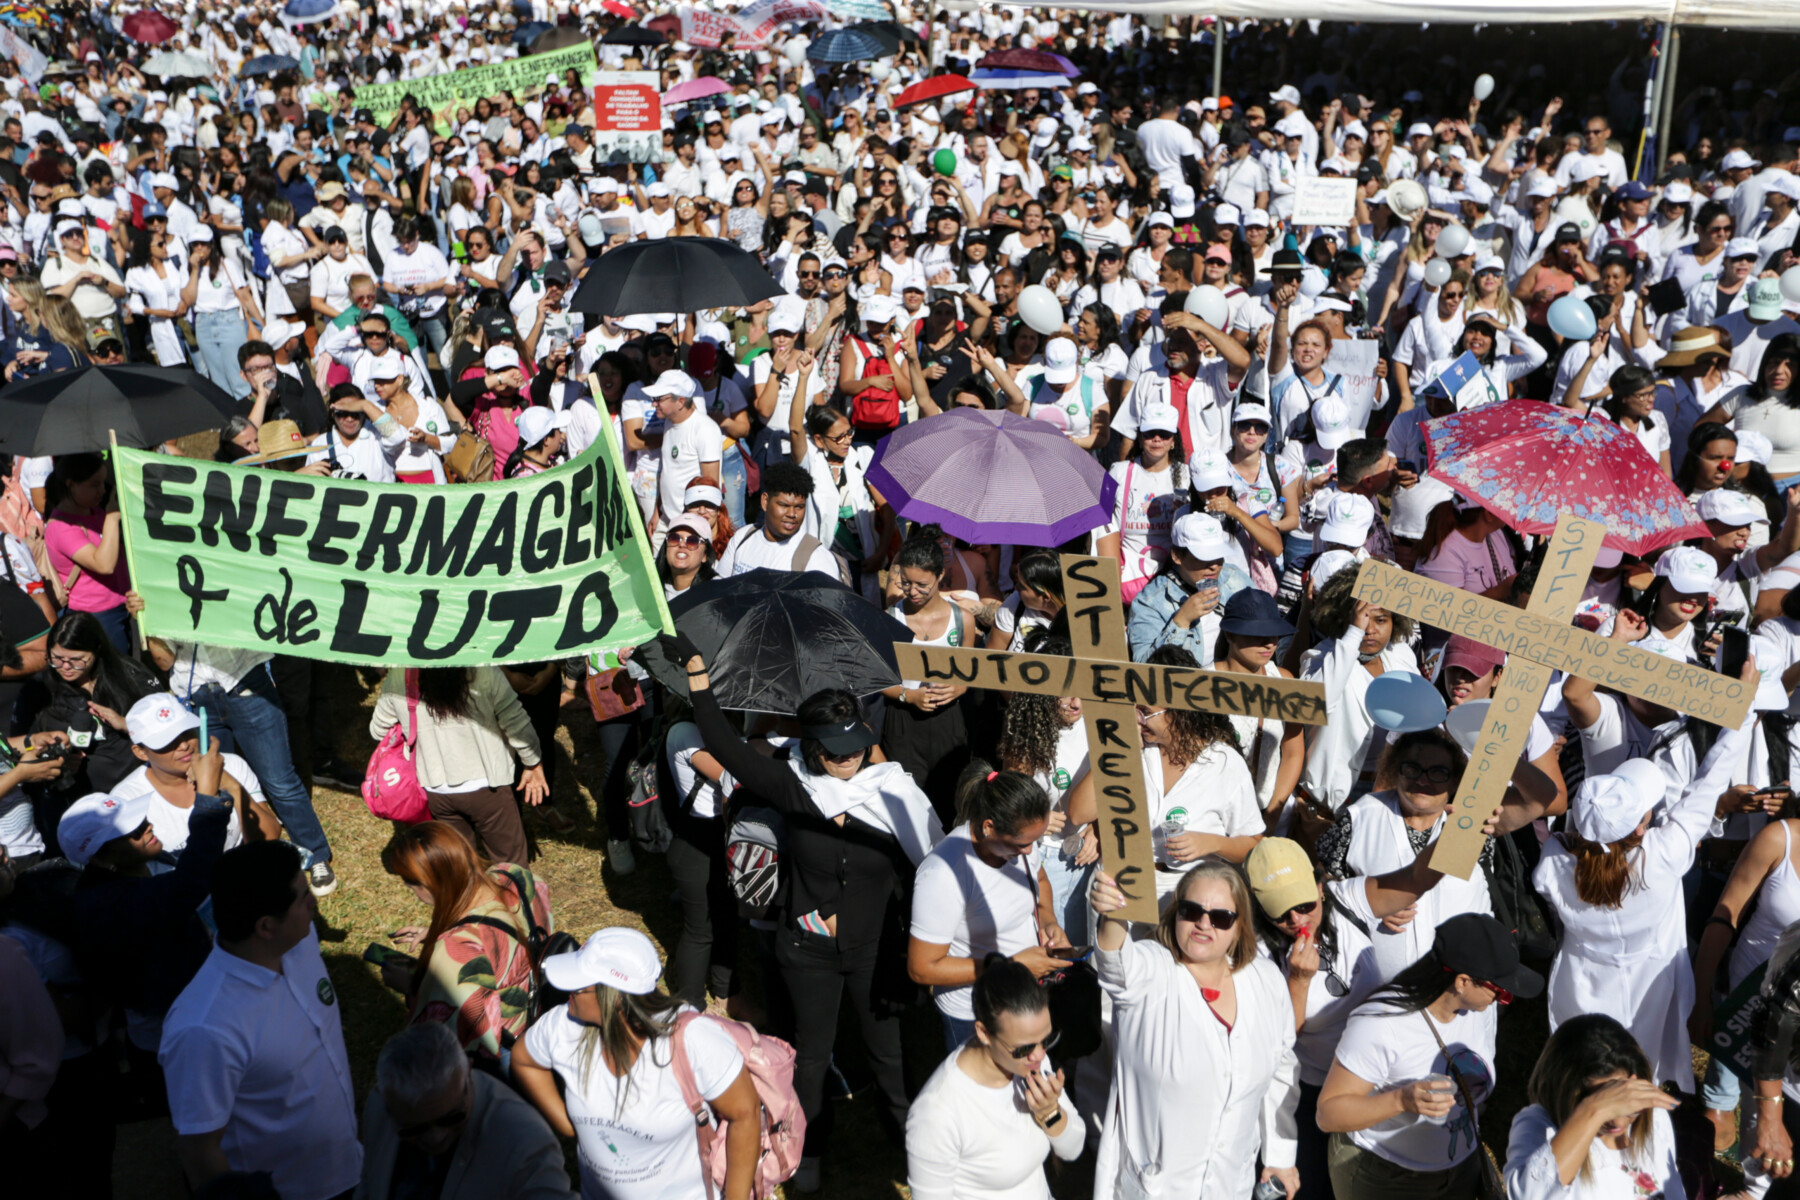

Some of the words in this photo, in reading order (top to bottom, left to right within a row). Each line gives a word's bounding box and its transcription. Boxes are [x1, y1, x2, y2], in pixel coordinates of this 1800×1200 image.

[520, 51, 591, 71] ENFERMAGEM
[142, 455, 632, 578] ENFERMAGEM
[253, 567, 321, 645] de
[329, 570, 620, 661] LUTO
[1364, 564, 1378, 582] A
[1461, 598, 1508, 624] QUE
[1515, 615, 1577, 646] ESTÁ
[1580, 637, 1609, 656] NO
[1613, 649, 1660, 671] SEU
[1666, 663, 1743, 704] BRAÇO,
[1397, 595, 1412, 614] A
[1421, 604, 1583, 673] ENFERMAGEM
[1587, 665, 1638, 688] QUE
[1503, 665, 1539, 693] NÃO
[1714, 1031, 1732, 1047] O
